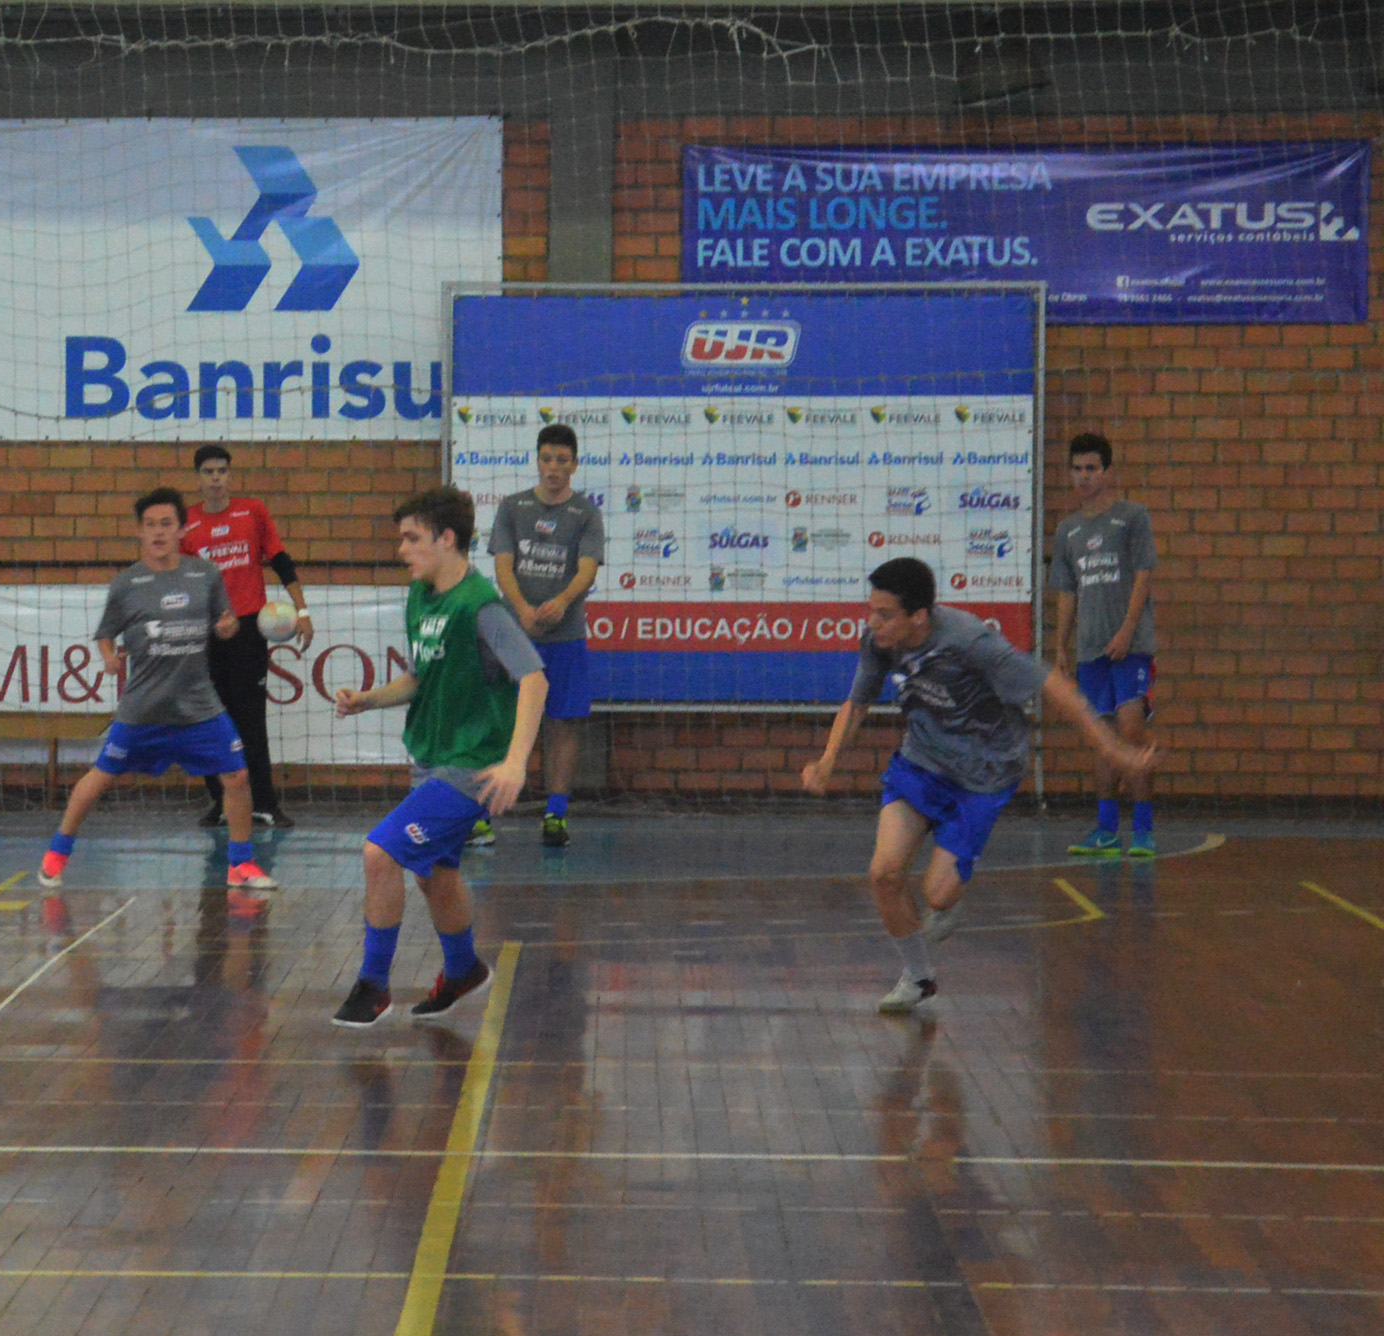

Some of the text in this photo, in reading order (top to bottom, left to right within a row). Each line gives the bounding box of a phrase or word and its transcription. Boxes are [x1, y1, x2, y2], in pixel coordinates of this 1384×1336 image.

[697, 162, 1053, 192] LEVE A SUA EMPRESA
[697, 196, 948, 231] MAIS LONGE.
[1086, 202, 1315, 230] EXATUS
[1169, 231, 1315, 245] serviços contábeis
[697, 236, 1039, 267] FALE COM A EXATUS.
[691, 329, 789, 360] UJR
[65, 333, 443, 421] Banrisu
[640, 413, 691, 425] FEEVALE
[470, 452, 529, 466] Banrisul
[634, 452, 694, 466] Banrisul
[716, 452, 776, 466] Banrisul
[799, 452, 859, 466] Banrisul
[882, 452, 943, 466] Banrisul
[967, 452, 1028, 466] Banrisul
[806, 493, 857, 505] RENNER
[640, 575, 692, 587] RENNER
[971, 575, 1024, 587] RENNER
[636, 614, 793, 645] EDUCAÇÃO
